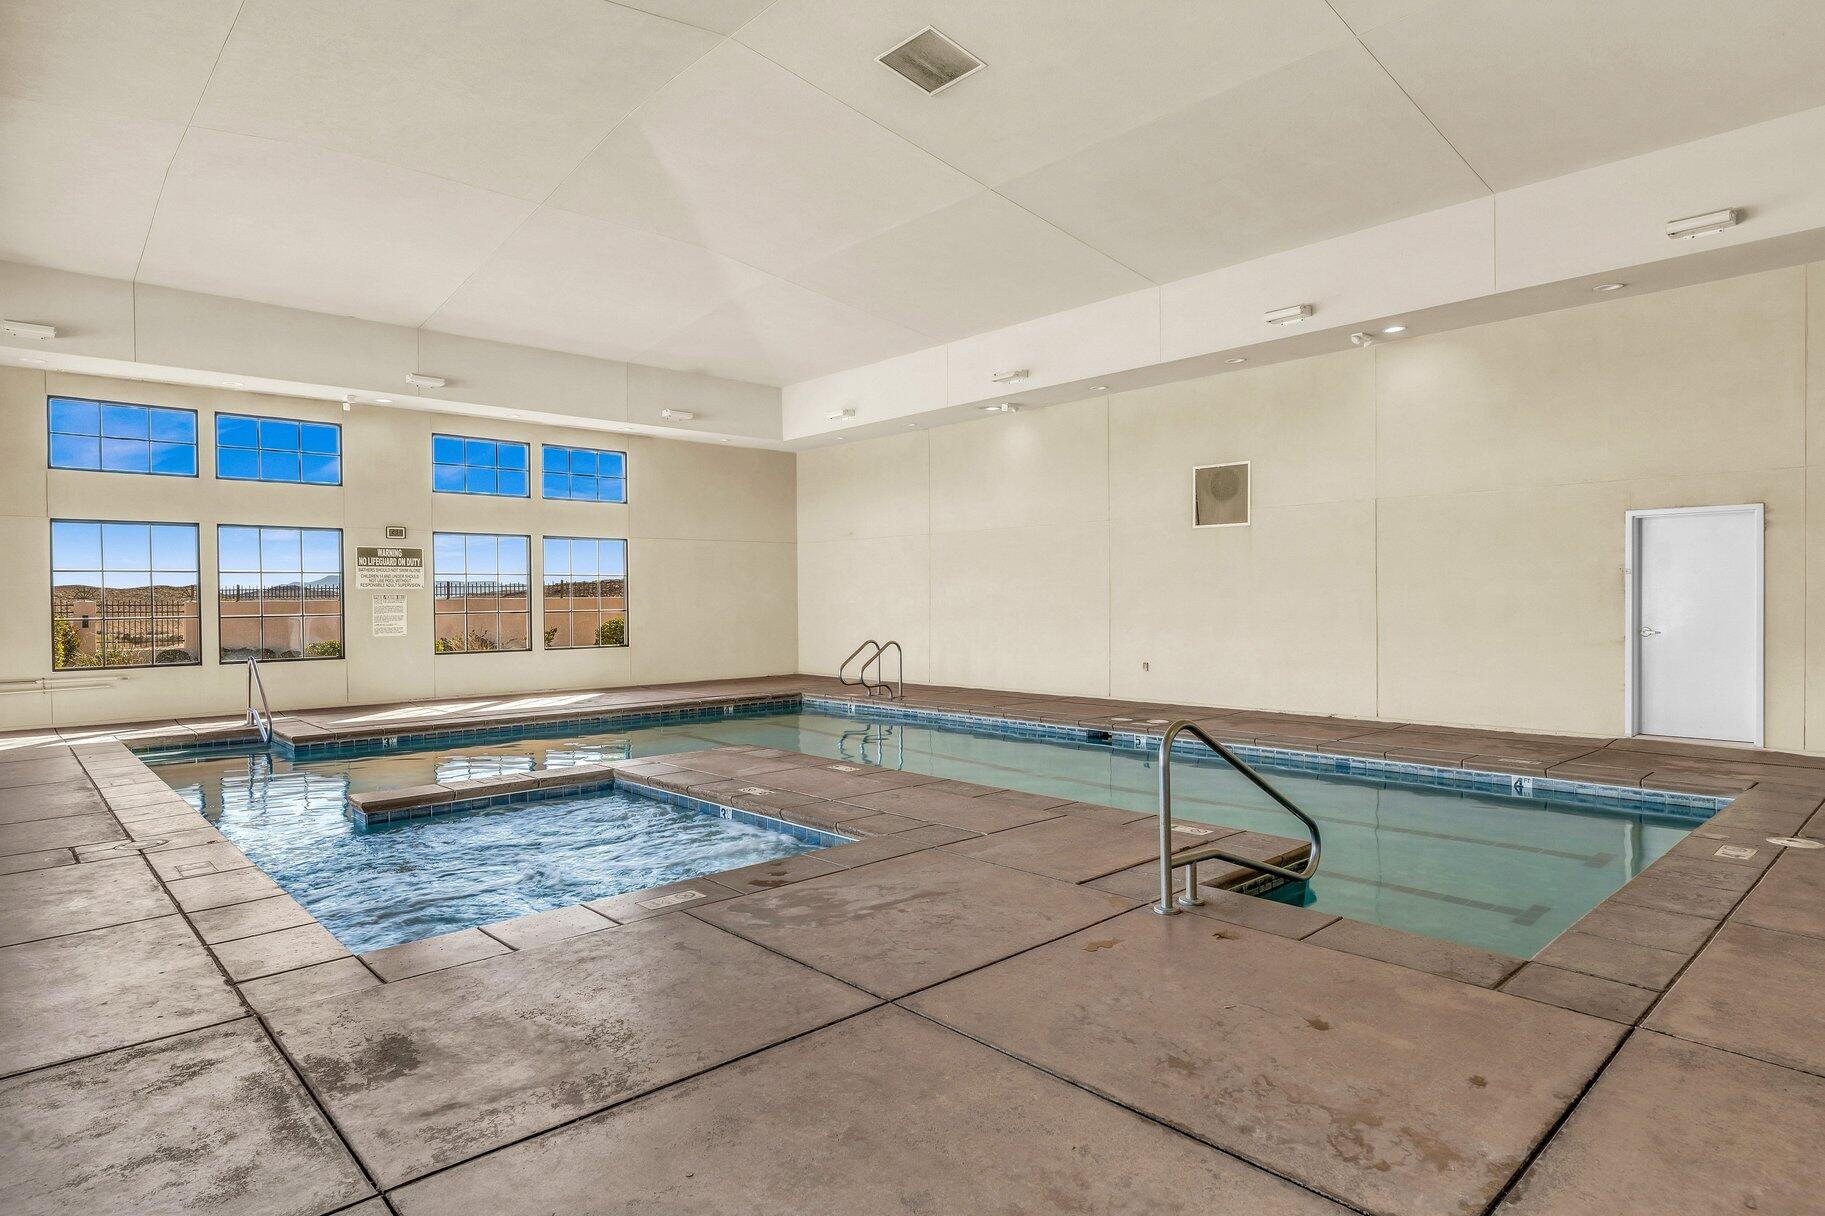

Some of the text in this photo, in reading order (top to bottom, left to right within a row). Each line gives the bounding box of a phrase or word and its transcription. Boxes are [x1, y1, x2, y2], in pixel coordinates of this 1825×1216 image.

[377, 549, 403, 557] WARNING
[358, 557, 421, 567] NO LIFEGUARD ON DUTY
